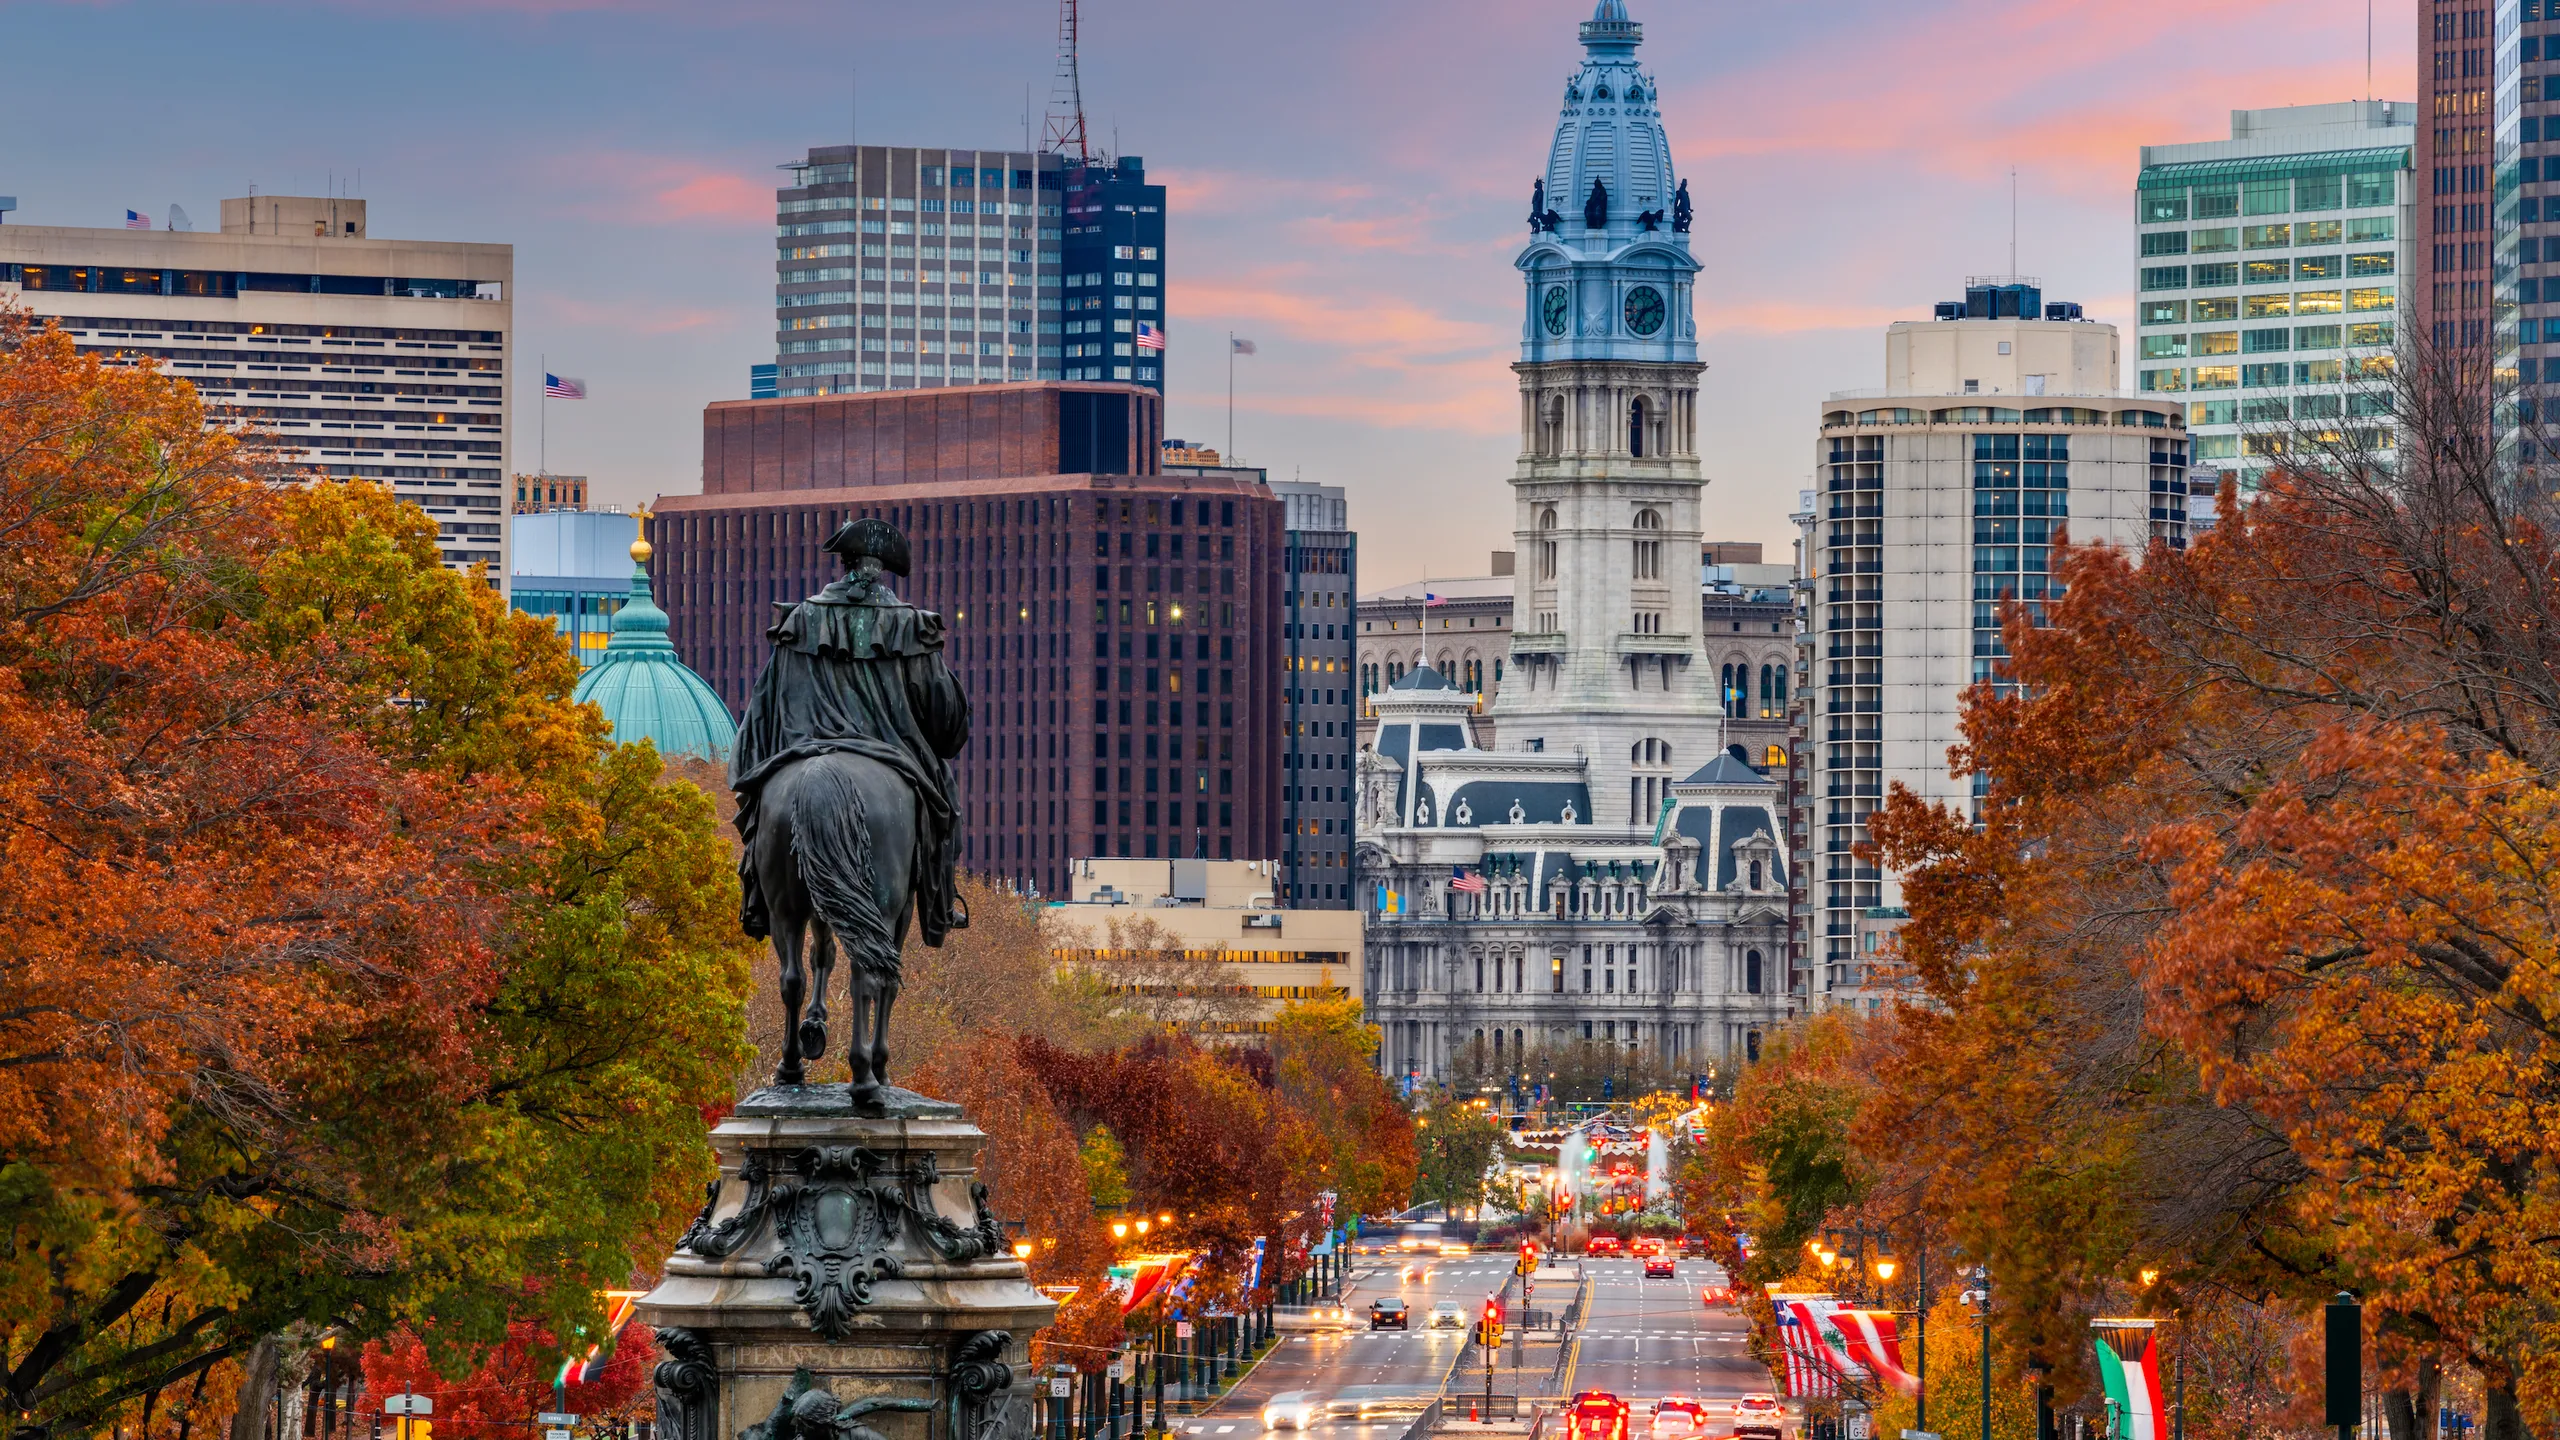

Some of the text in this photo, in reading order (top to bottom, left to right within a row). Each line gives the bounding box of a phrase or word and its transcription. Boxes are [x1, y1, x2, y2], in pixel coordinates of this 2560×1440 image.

[740, 1346, 929, 1367] PENNSYLVANIA
[1110, 1368, 1120, 1376] H-1
[1054, 1386, 1066, 1395] G-1
[1853, 1427, 1867, 1437] G-2
